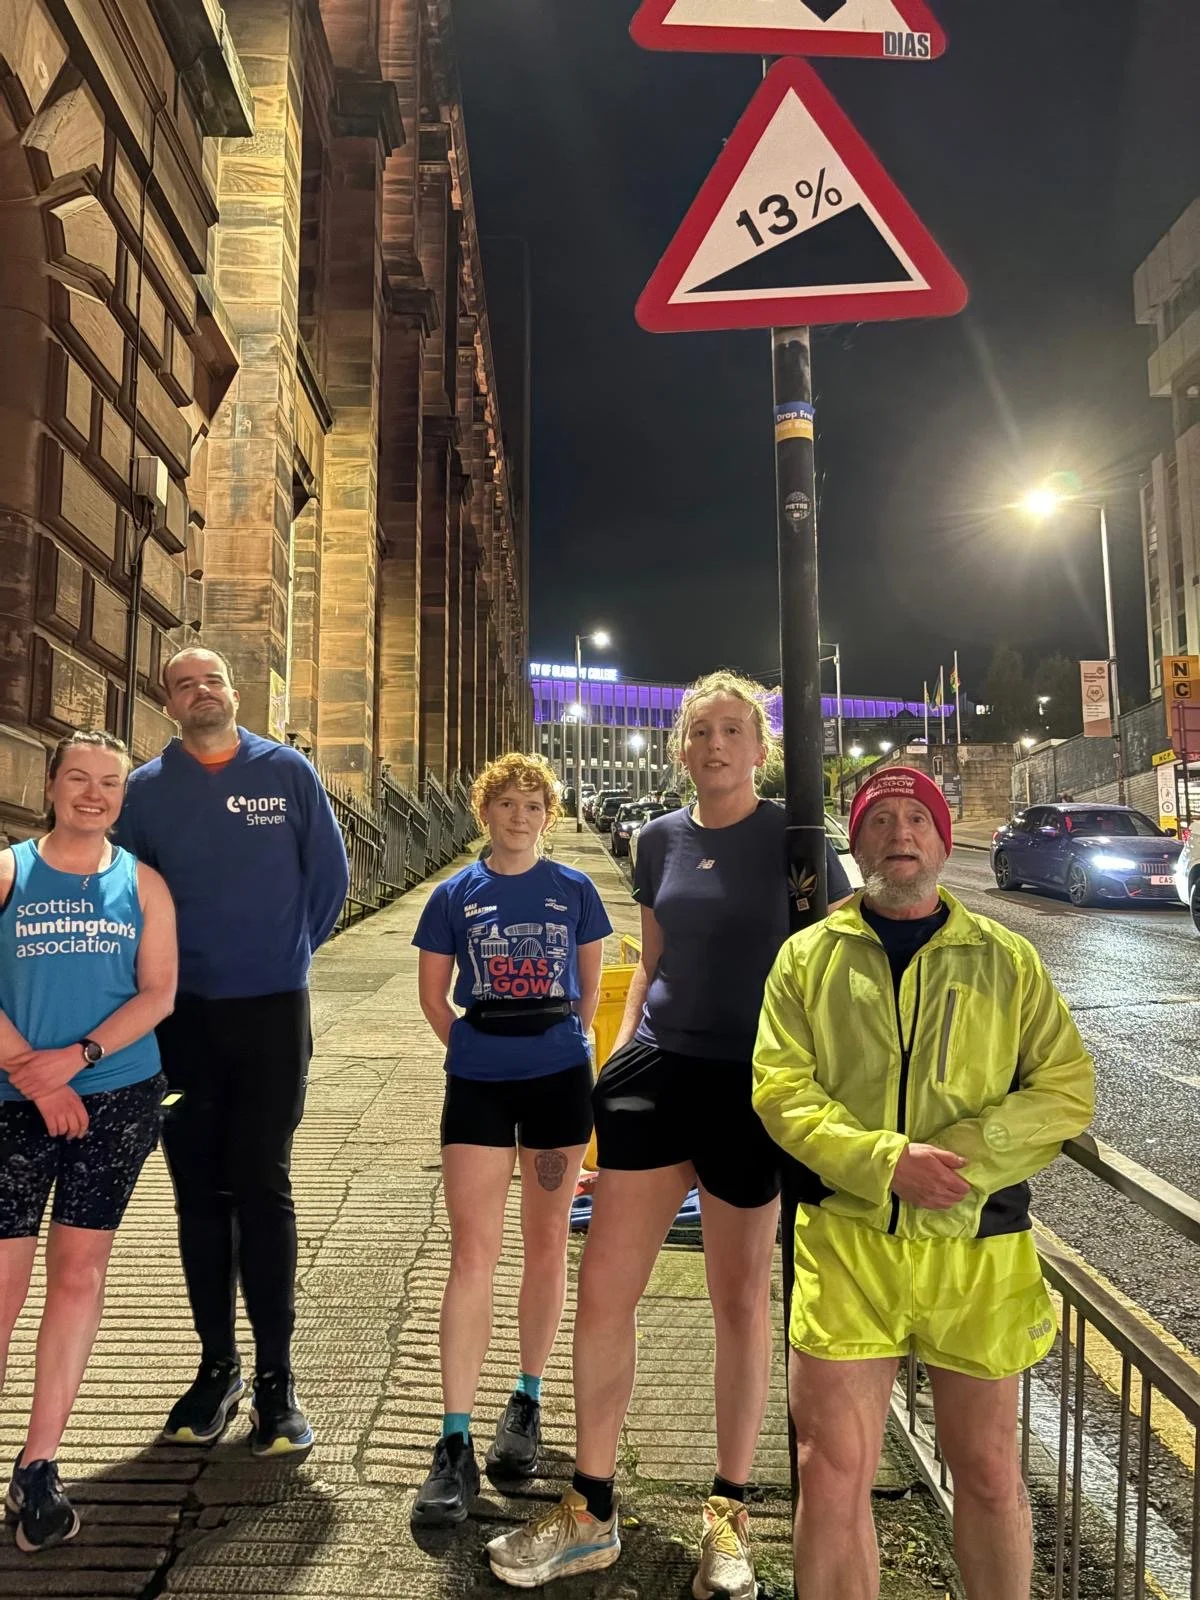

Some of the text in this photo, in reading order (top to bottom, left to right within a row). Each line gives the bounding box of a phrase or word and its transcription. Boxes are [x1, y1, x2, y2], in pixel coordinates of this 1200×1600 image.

[885, 31, 929, 57] DIAS
[736, 167, 842, 247] 13%
[777, 411, 797, 421] Drop
[247, 797, 287, 812] DOPE
[17, 898, 94, 918] scottish
[15, 916, 136, 939] huntington's
[16, 936, 120, 958] association
[489, 955, 549, 976] GLAS
[492, 976, 551, 997] GOW
